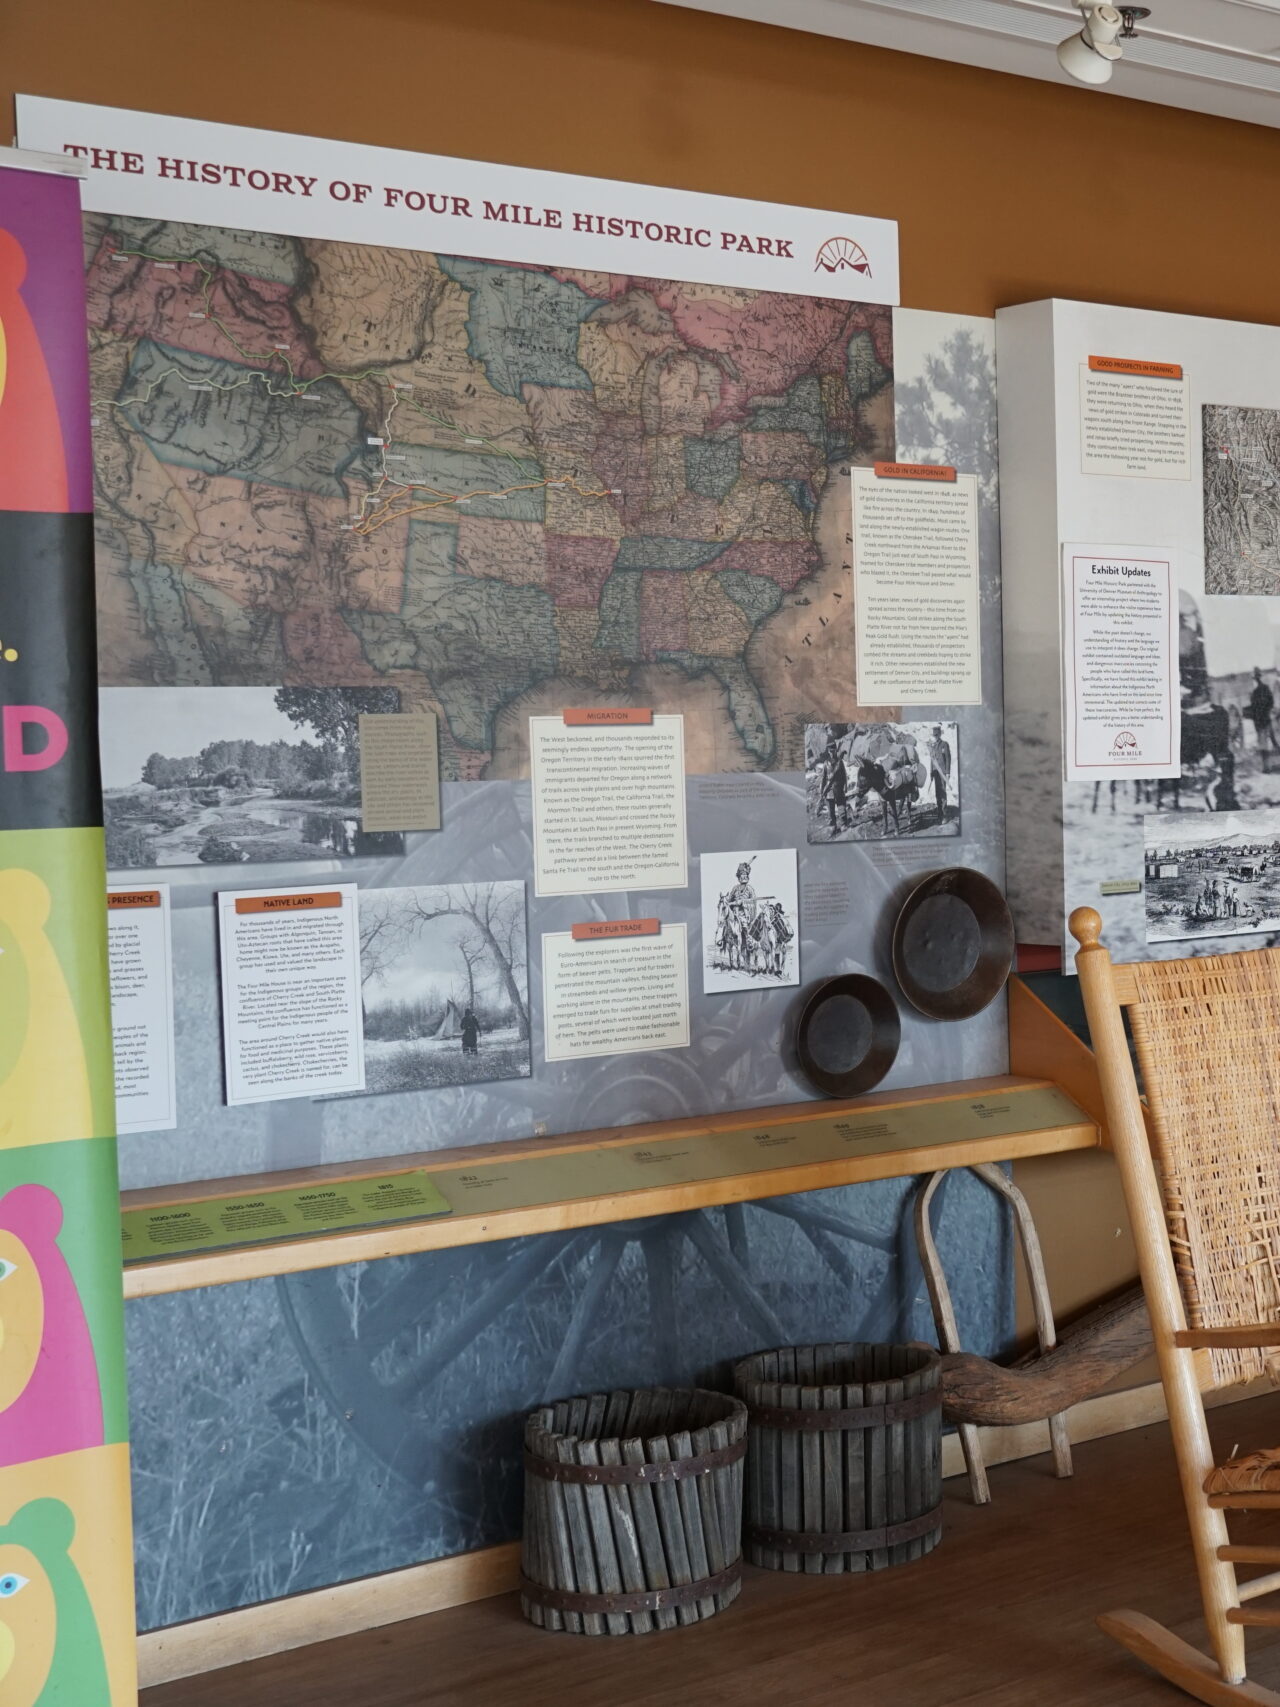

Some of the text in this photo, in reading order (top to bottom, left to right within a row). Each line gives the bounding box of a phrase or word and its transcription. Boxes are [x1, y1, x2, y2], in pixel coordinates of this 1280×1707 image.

[64, 144, 794, 258] THE HISTORY OF FOUR MILE HISTORIC PARK
[910, 468, 947, 476] CALIFORNIA!
[1092, 565, 1151, 577] Exhibit Updates
[112, 895, 153, 904] PRESENCE
[264, 899, 290, 907] NATIVE
